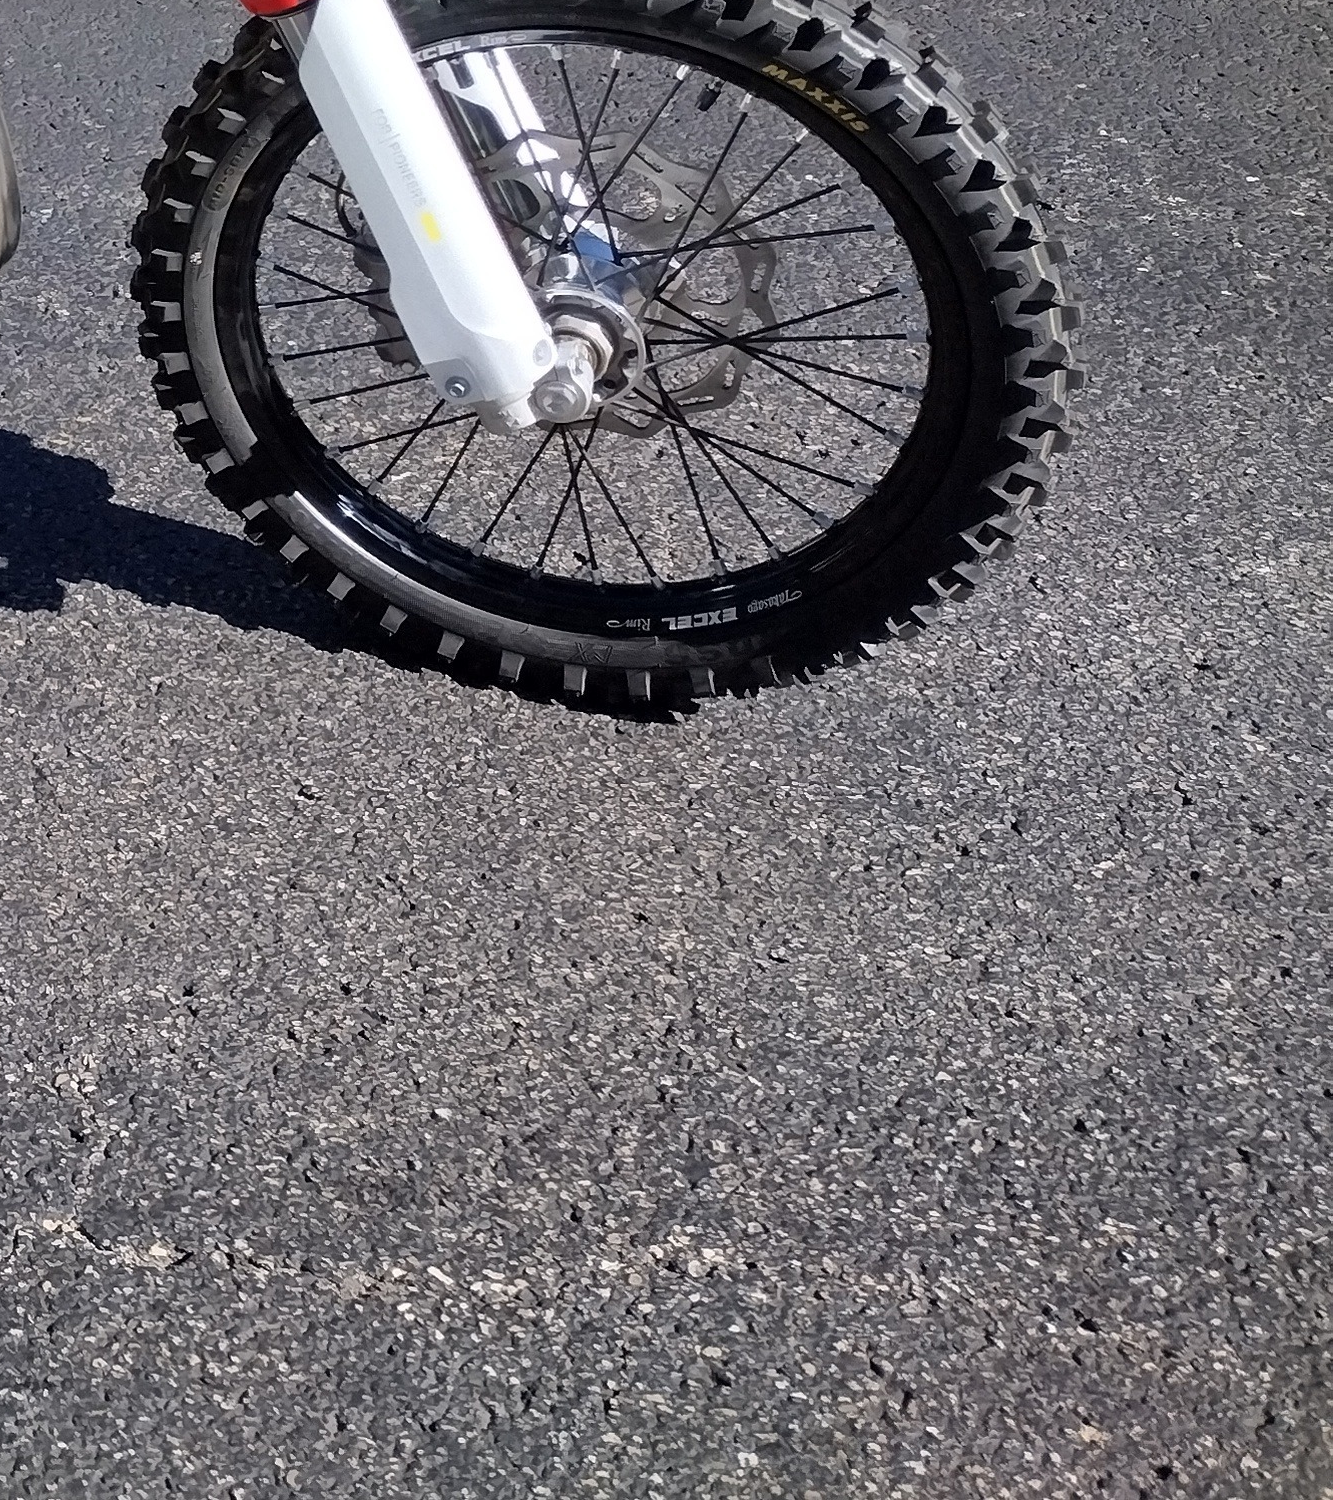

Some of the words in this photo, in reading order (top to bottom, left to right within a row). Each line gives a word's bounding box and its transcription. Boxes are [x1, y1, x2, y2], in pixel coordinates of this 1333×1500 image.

[761, 64, 870, 132] MAXXIS
[606, 618, 651, 632] Rim
[661, 606, 739, 631] EXCEL
